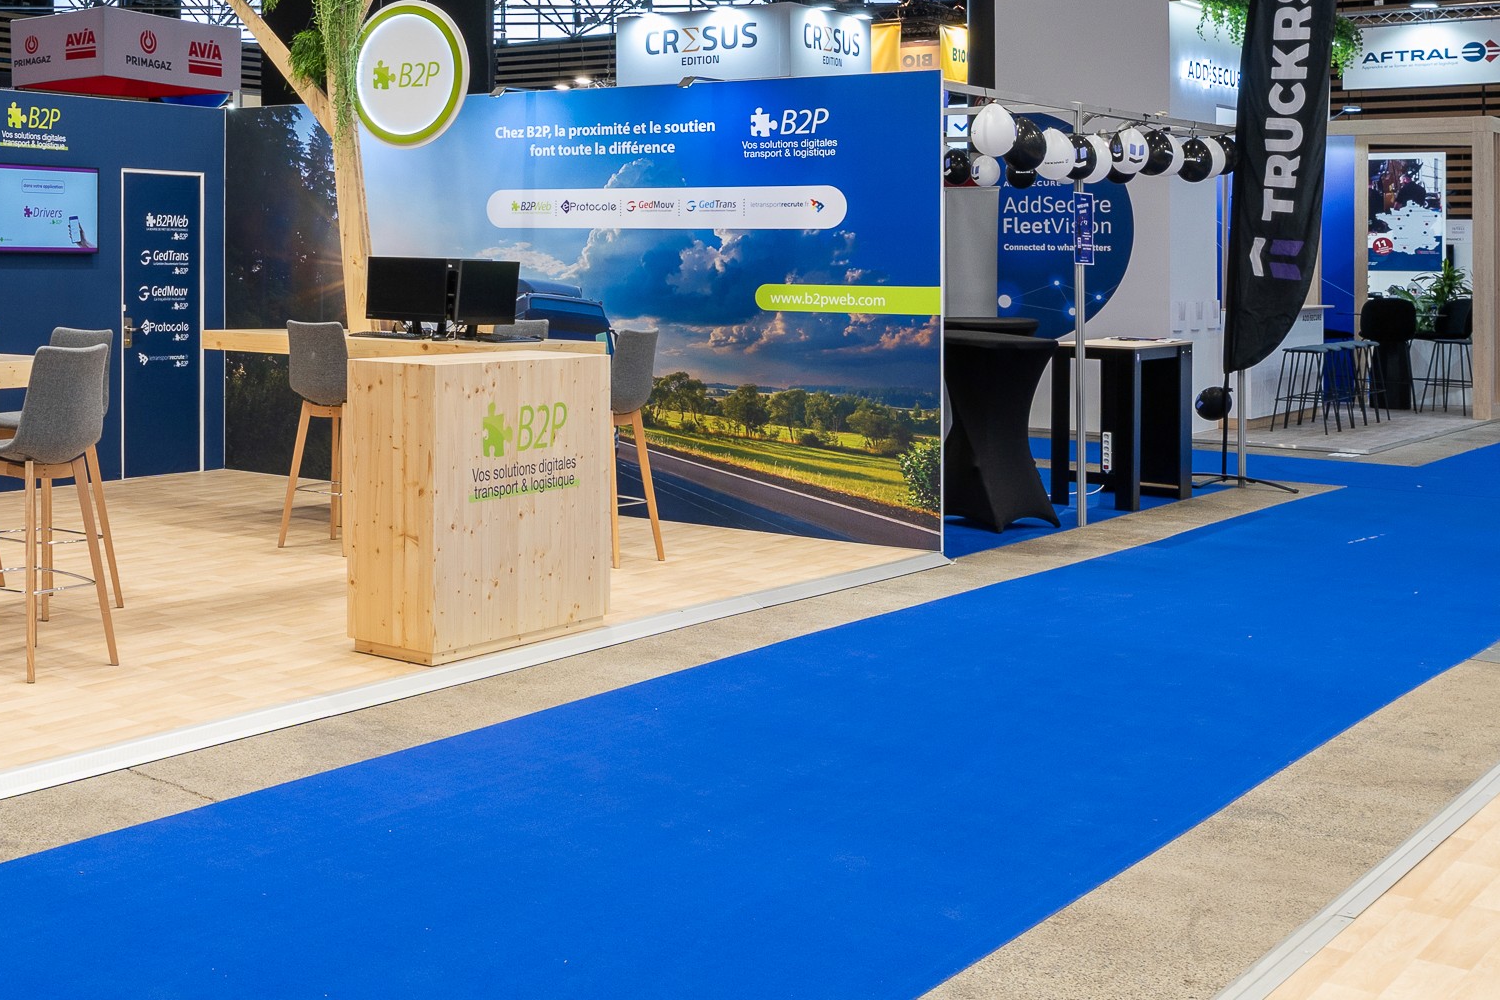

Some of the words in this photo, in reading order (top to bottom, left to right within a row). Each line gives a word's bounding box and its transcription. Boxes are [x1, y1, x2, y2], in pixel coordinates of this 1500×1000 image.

[13, 55, 51, 68] PRIMAGAZ
[125, 54, 172, 71] PRIMAGAZ
[681, 54, 720, 66] EDITION
[822, 56, 843, 67] EDITION
[1362, 48, 1458, 64] AFTRAL
[398, 61, 440, 88] B2P
[28, 106, 61, 129] B2P
[780, 107, 830, 135] B2P
[1, 130, 13, 138] Vos
[14, 131, 40, 140] solutions
[41, 133, 66, 142] digitales
[495, 126, 524, 139] Chez
[527, 125, 552, 140] B2P,
[555, 124, 566, 137] la
[569, 121, 630, 140] proximité
[633, 122, 646, 135] et
[649, 120, 662, 134] le
[664, 119, 716, 133] soutien
[530, 144, 555, 157] font
[557, 143, 592, 156] toute
[594, 142, 606, 155] la
[608, 141, 676, 155] différence
[741, 140, 758, 150] Vos
[759, 139, 799, 149] solutions
[801, 138, 838, 149] digitales
[744, 149, 782, 159] transport
[784, 149, 791, 157] &
[793, 148, 836, 159] logistique
[520, 201, 551, 211] B2PWeb
[638, 200, 675, 209] GedMouv
[699, 199, 737, 209] GedTrans
[1003, 195, 1111, 214] AddSecre
[33, 207, 63, 218] Drivers
[156, 214, 189, 227] B2PWeb
[1004, 243, 1046, 252] Connected
[153, 250, 189, 261] GedTrans
[152, 285, 188, 296] GedMouv
[770, 292, 886, 308] www.b2pweb.com
[516, 401, 568, 452] B2P
[472, 467, 490, 483] Vos
[493, 461, 536, 480] solutions
[538, 456, 577, 476] digitales
[474, 482, 519, 500] transport
[521, 480, 528, 492] &
[530, 474, 575, 493] logistique
